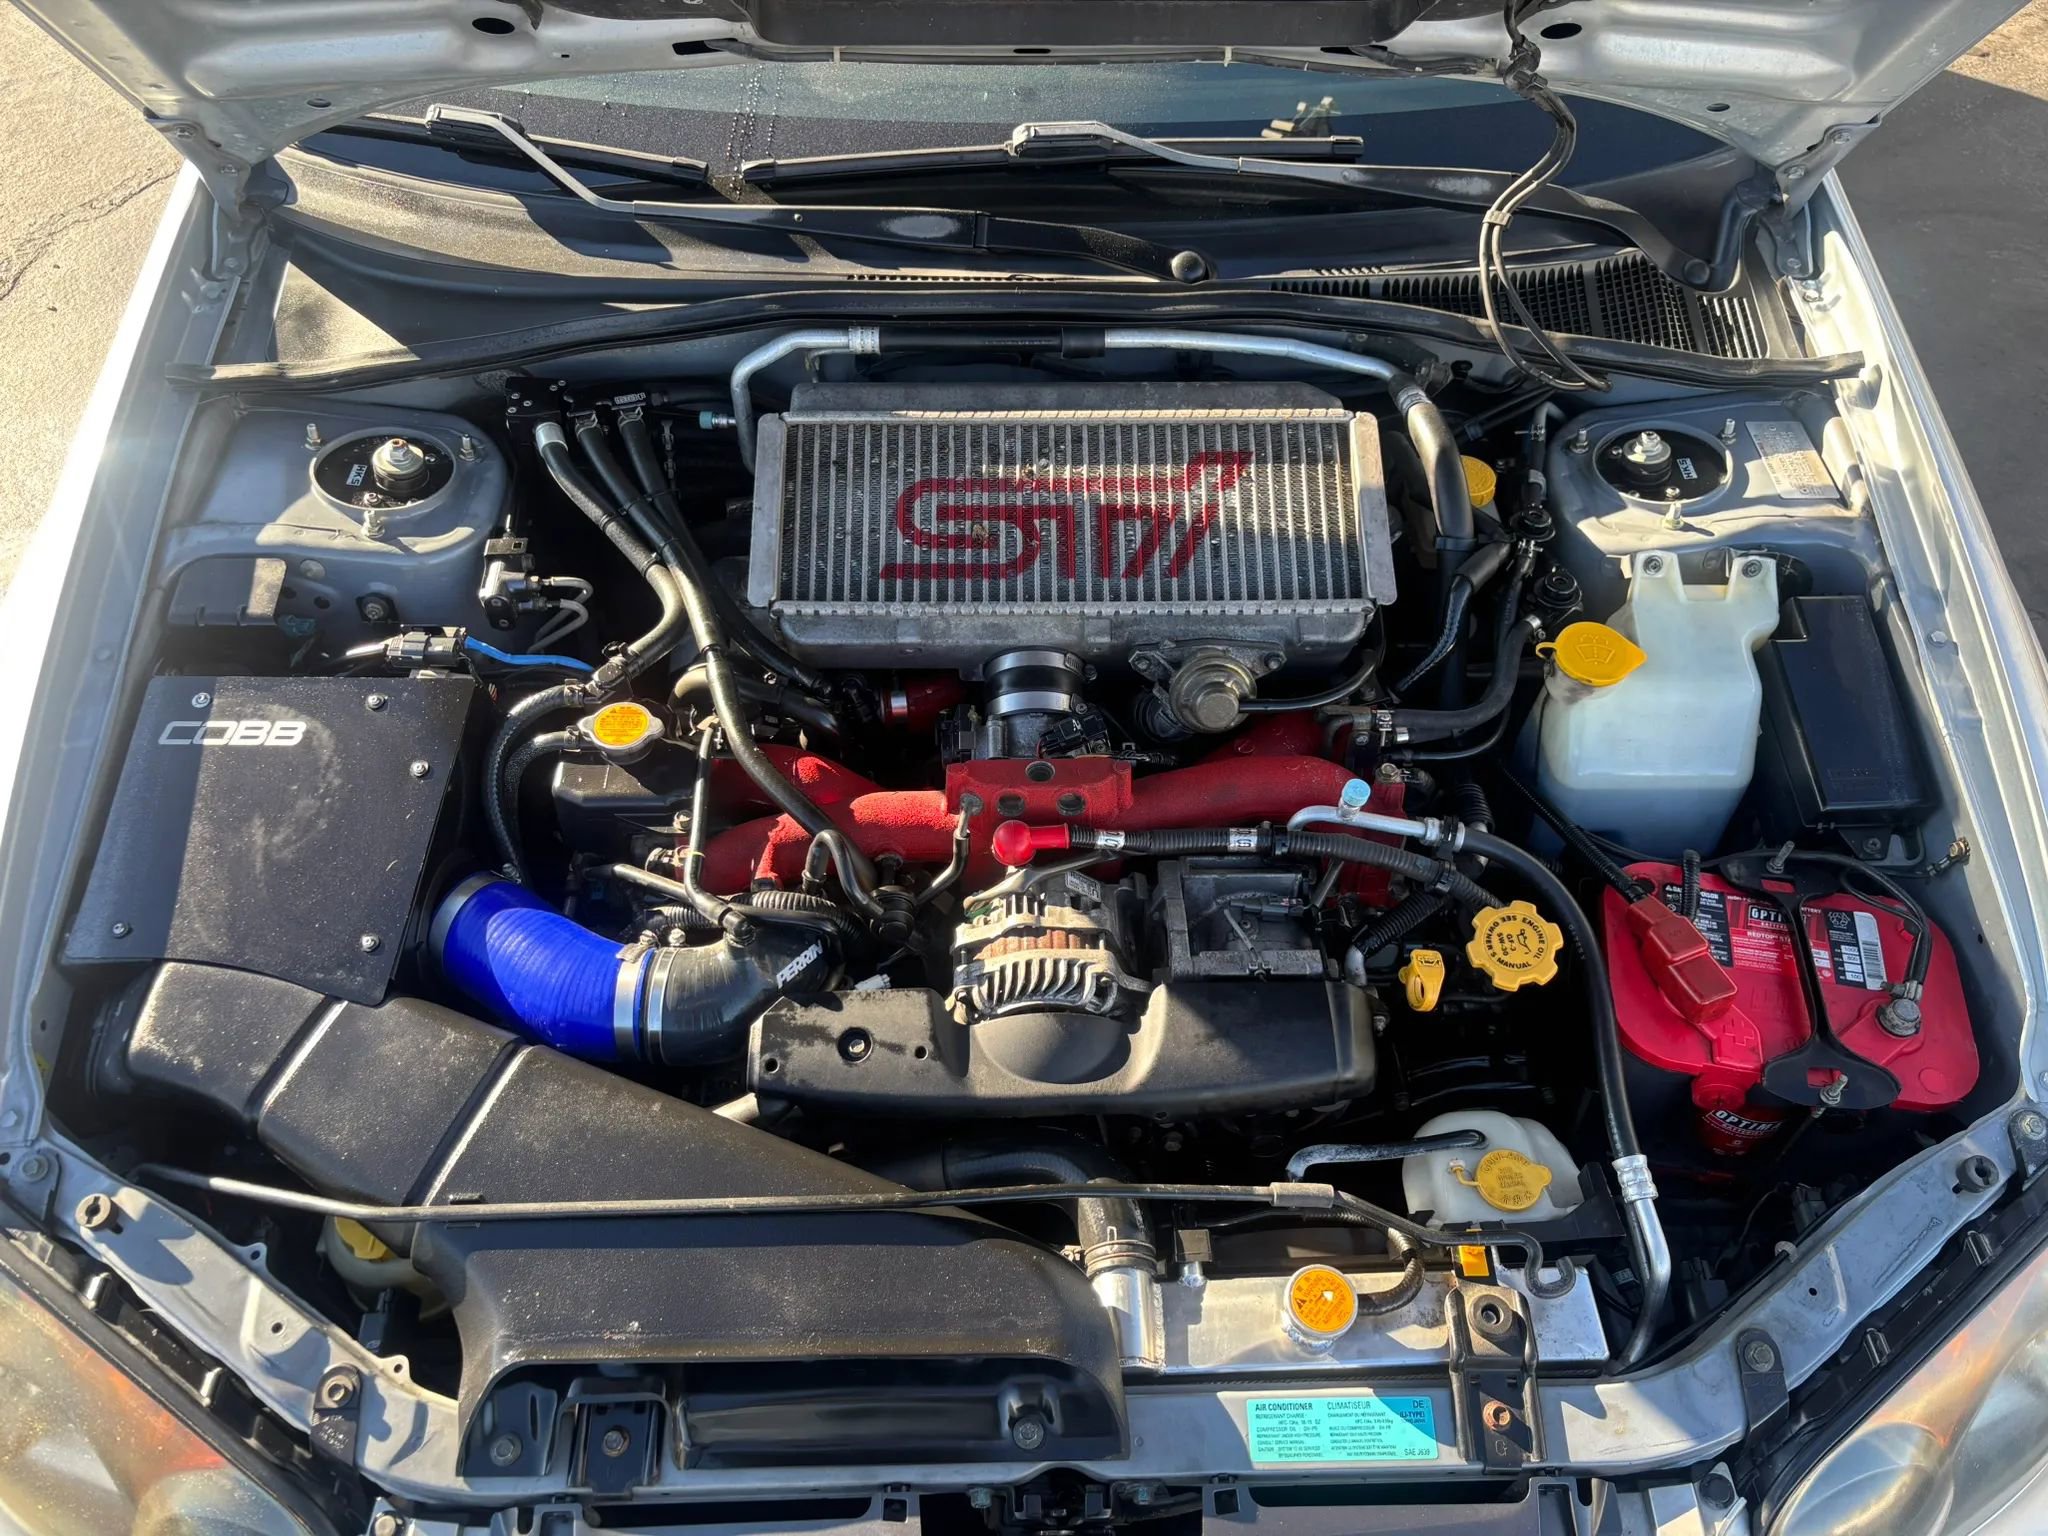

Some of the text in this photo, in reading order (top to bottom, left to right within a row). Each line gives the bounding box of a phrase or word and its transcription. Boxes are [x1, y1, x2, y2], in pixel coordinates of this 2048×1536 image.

[350, 465, 366, 485] HKS
[1679, 459, 1694, 479] HKS
[880, 451, 1254, 580] STI
[158, 720, 307, 746] COBB
[1500, 915, 1518, 923] SEE
[1521, 917, 1546, 960] ENGINE OIL
[776, 939, 823, 989] PERRIN
[1496, 957, 1532, 969] MANUAL
[1255, 1402, 1313, 1412] AIR CONDITIONER
[1327, 1400, 1371, 1410] CLIMATISEUR
[1404, 1448, 1416, 1456] SAE
